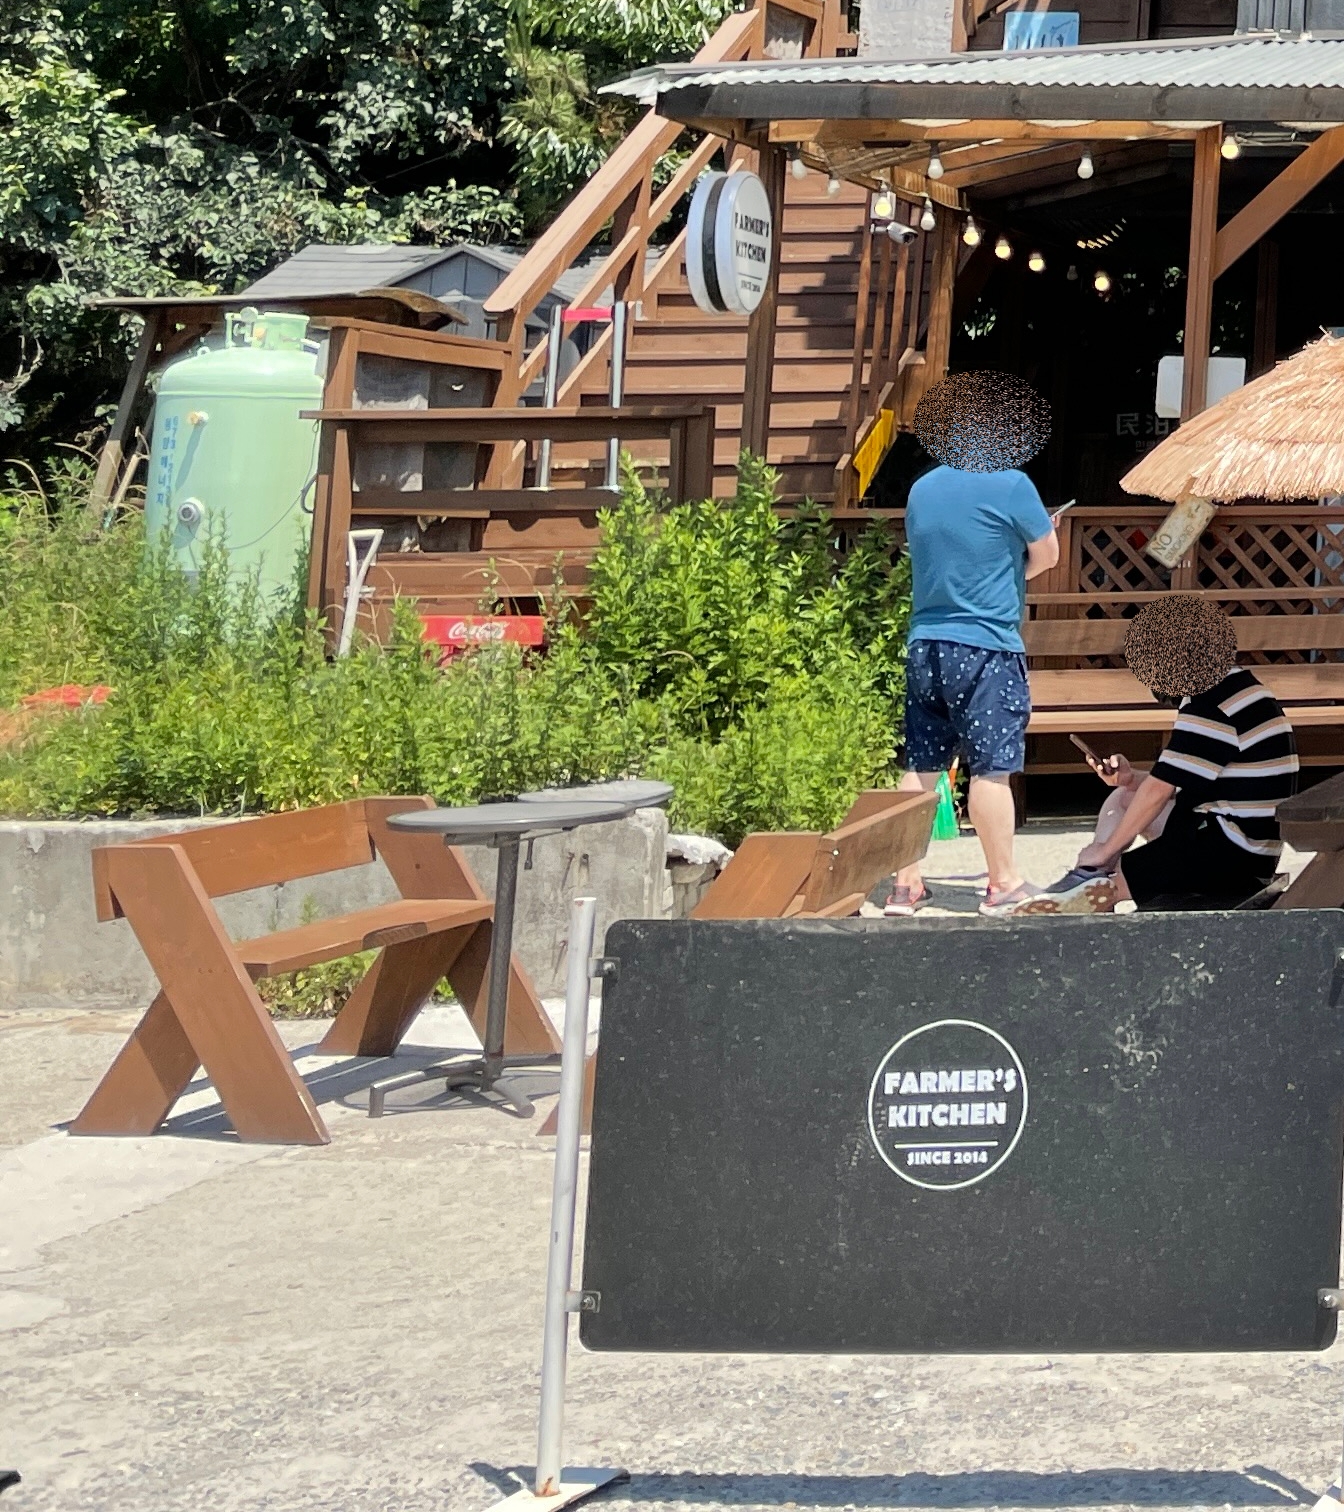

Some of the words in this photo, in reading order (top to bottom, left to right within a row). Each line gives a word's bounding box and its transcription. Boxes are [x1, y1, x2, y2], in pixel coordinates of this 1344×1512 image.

[735, 239, 767, 264] KITCHEN
[1152, 533, 1172, 556] NO
[884, 1068, 1017, 1095] FARMER'S
[888, 1101, 1007, 1128] KITCHEN
[906, 1151, 951, 1166] SINCE
[954, 1150, 989, 1164] 2014
